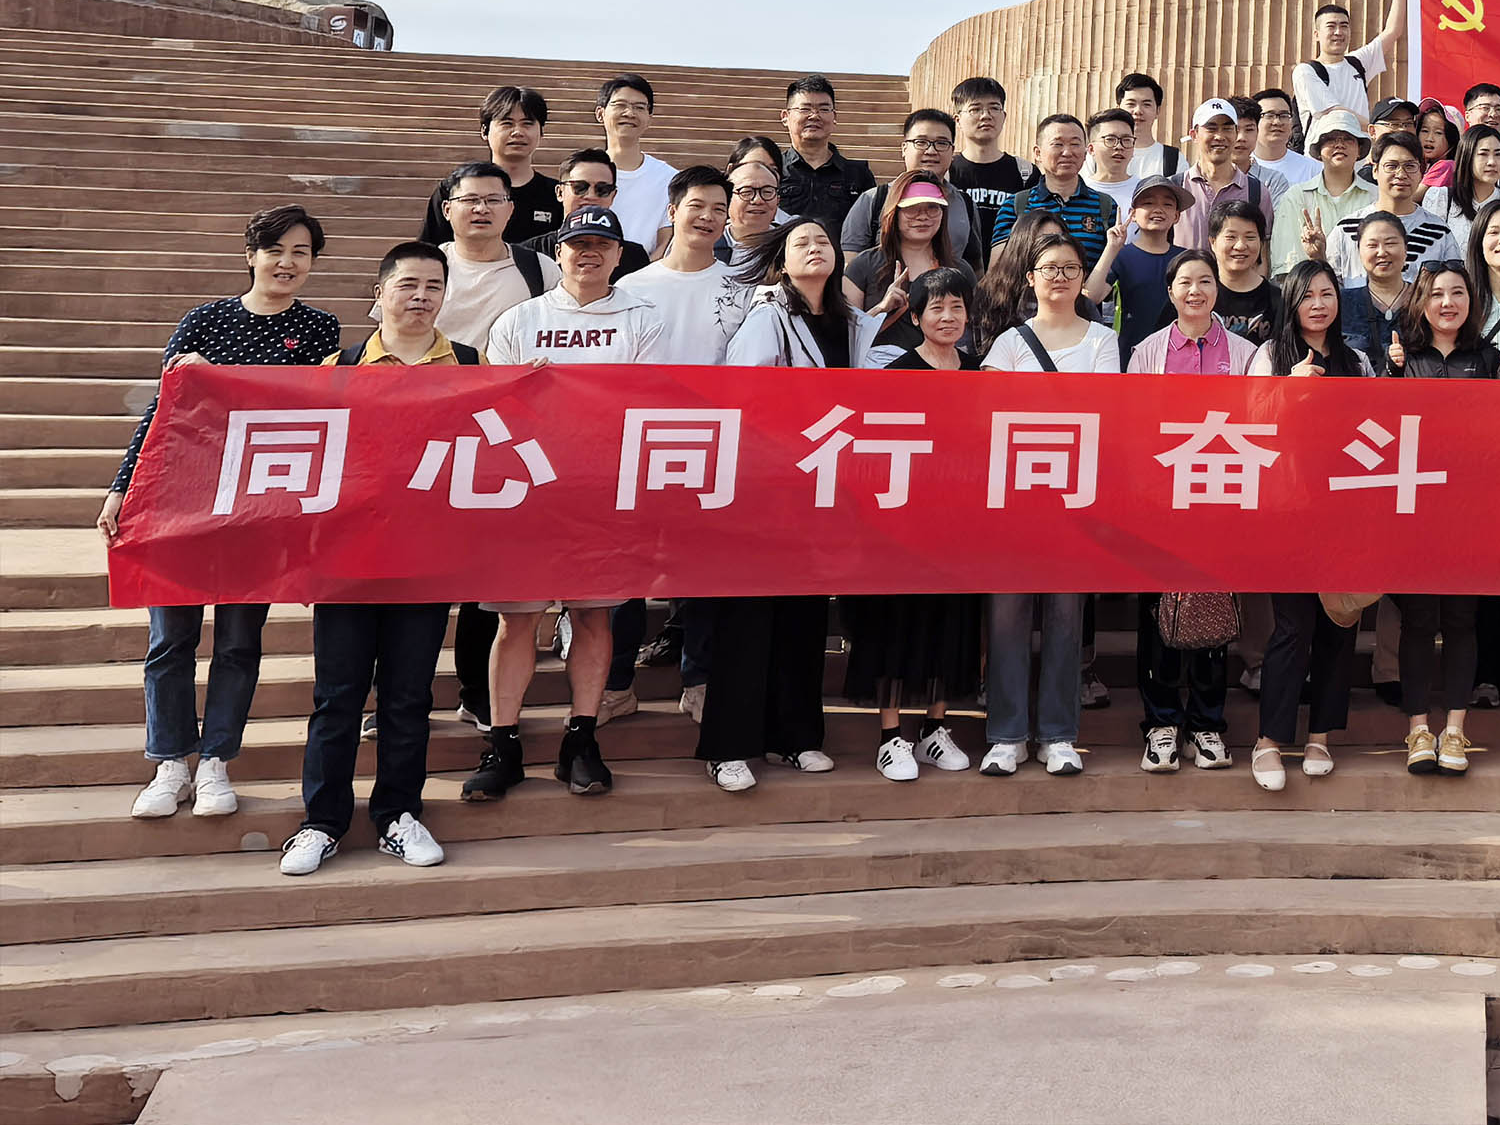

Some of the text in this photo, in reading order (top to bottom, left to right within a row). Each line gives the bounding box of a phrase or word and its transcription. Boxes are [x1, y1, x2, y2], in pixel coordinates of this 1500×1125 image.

[966, 188, 1012, 206] OPTO
[570, 212, 612, 229] FILA
[535, 329, 617, 348] HEART
[211, 406, 1448, 516] 同心同行同奋斗
